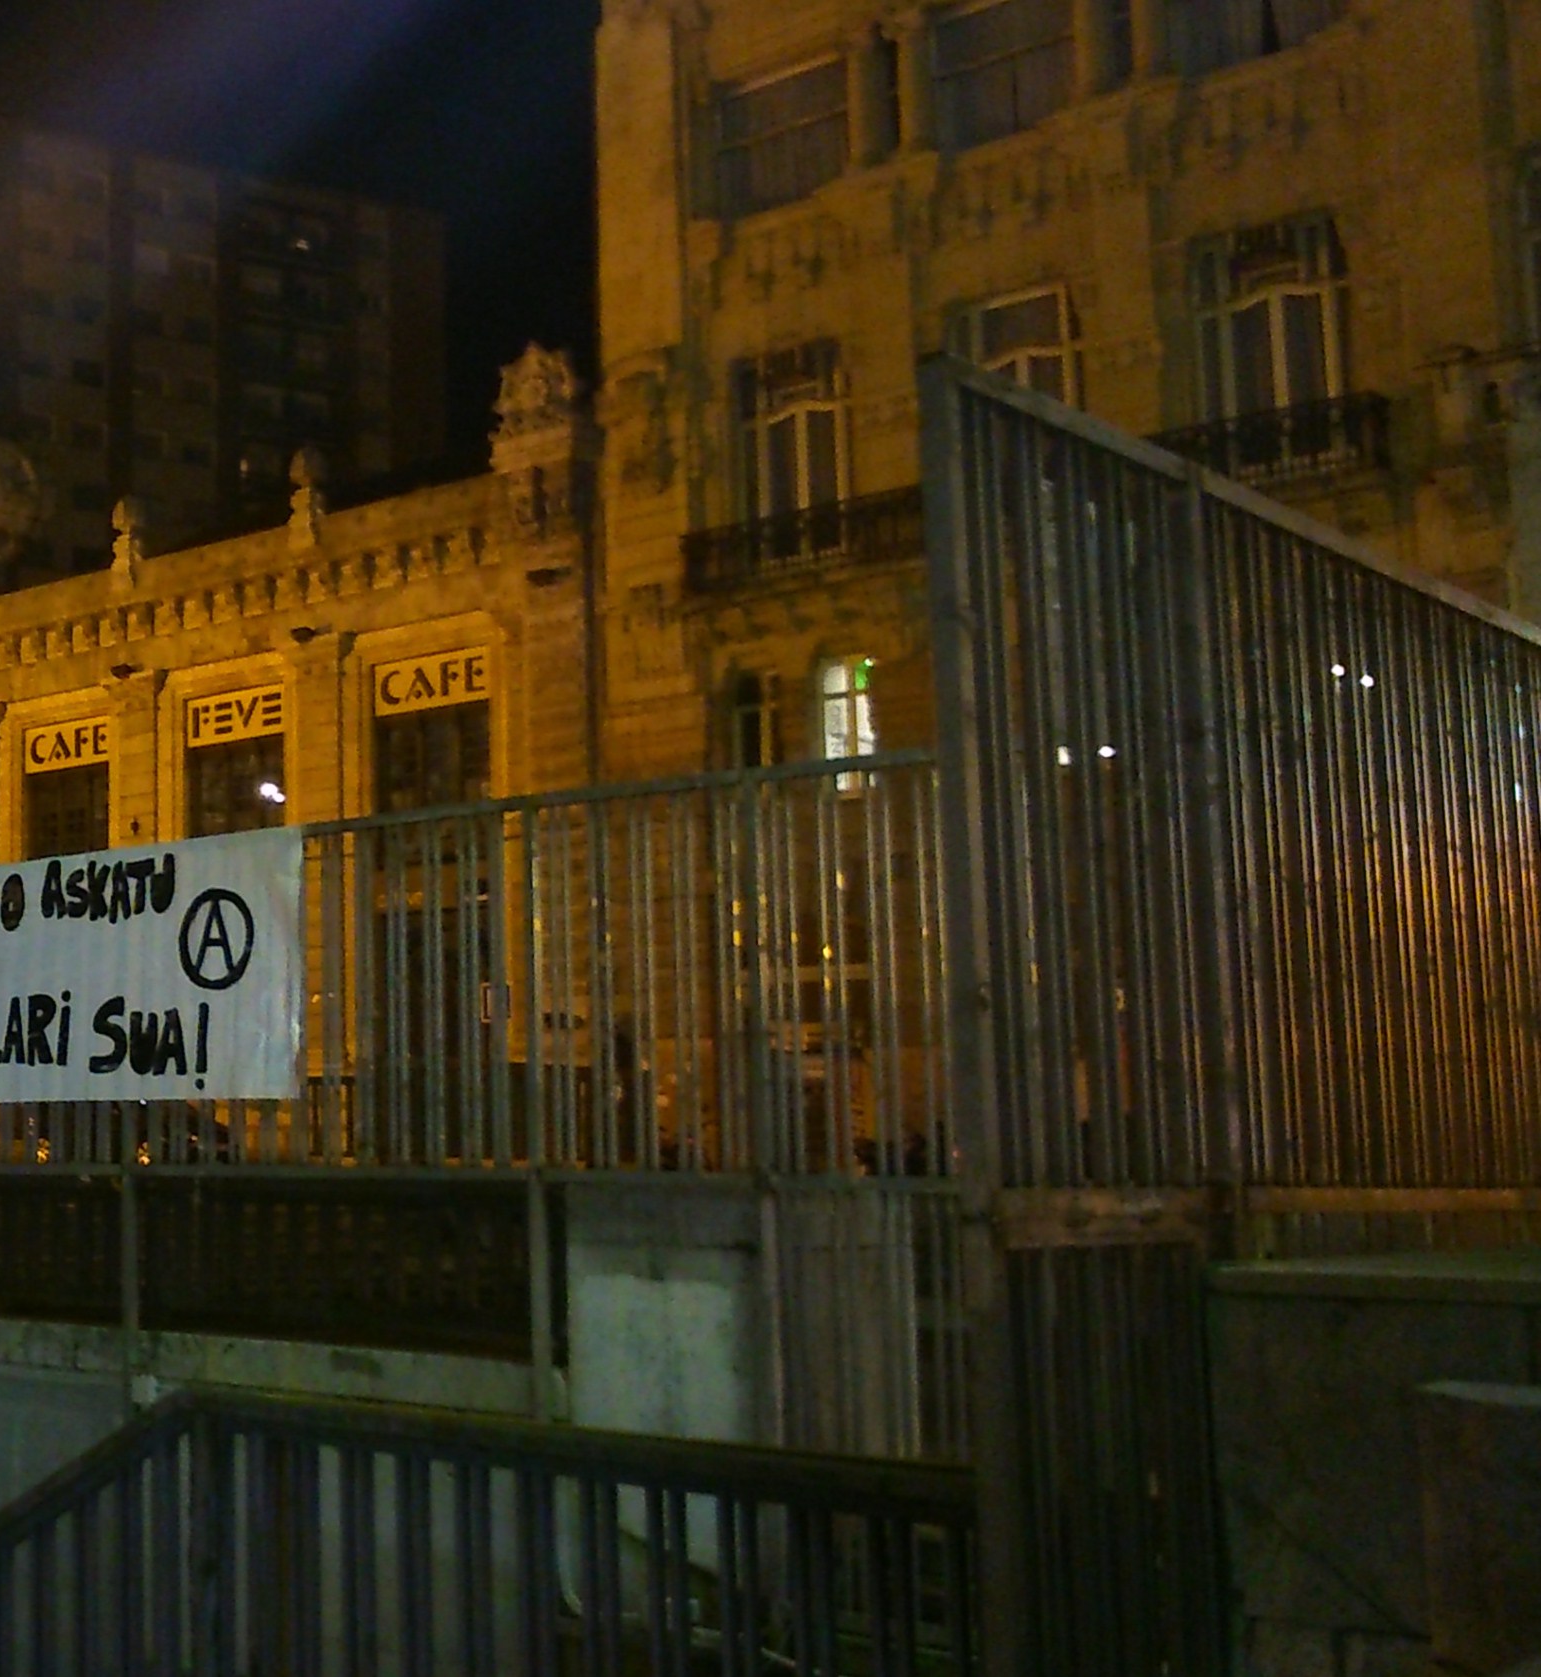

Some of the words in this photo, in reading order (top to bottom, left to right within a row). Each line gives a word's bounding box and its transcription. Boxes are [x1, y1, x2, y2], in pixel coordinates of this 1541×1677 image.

[380, 656, 486, 705] CAFE
[192, 692, 282, 738] FEVE
[30, 726, 108, 765] CAFE
[41, 853, 176, 923] ASKATU
[90, 997, 210, 1090] SUA!
